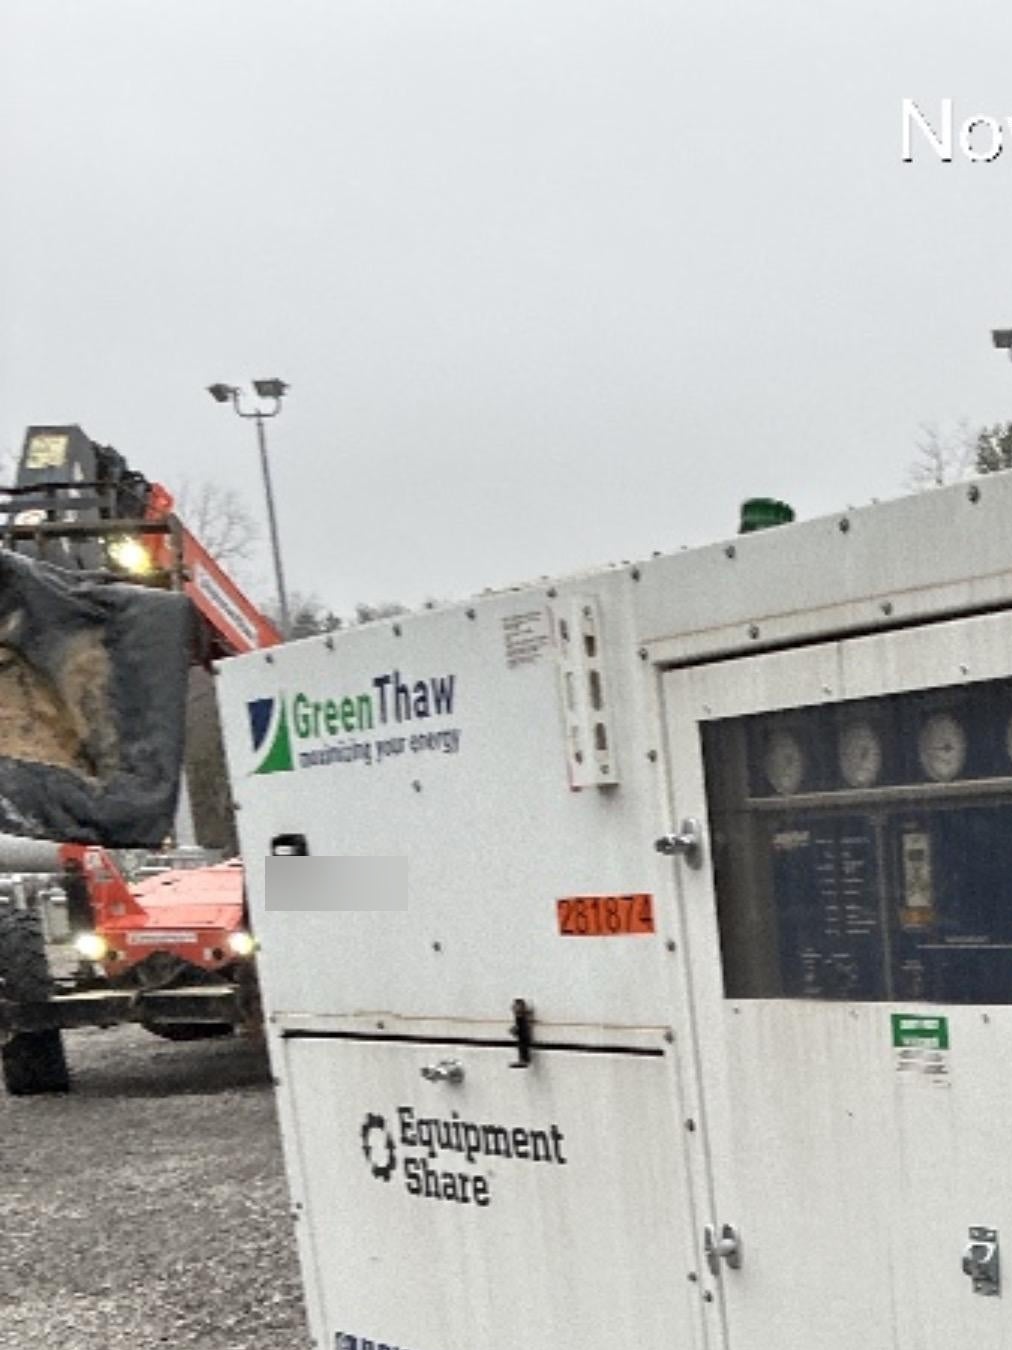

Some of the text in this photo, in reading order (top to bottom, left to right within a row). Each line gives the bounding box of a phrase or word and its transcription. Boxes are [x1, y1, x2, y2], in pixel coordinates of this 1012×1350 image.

[293, 669, 456, 739] GreenThaw
[375, 737, 406, 764] your
[409, 729, 462, 754] energy
[558, 893, 654, 936] 281874
[397, 1106, 567, 1165] Equipment
[403, 1156, 491, 1207] Share
